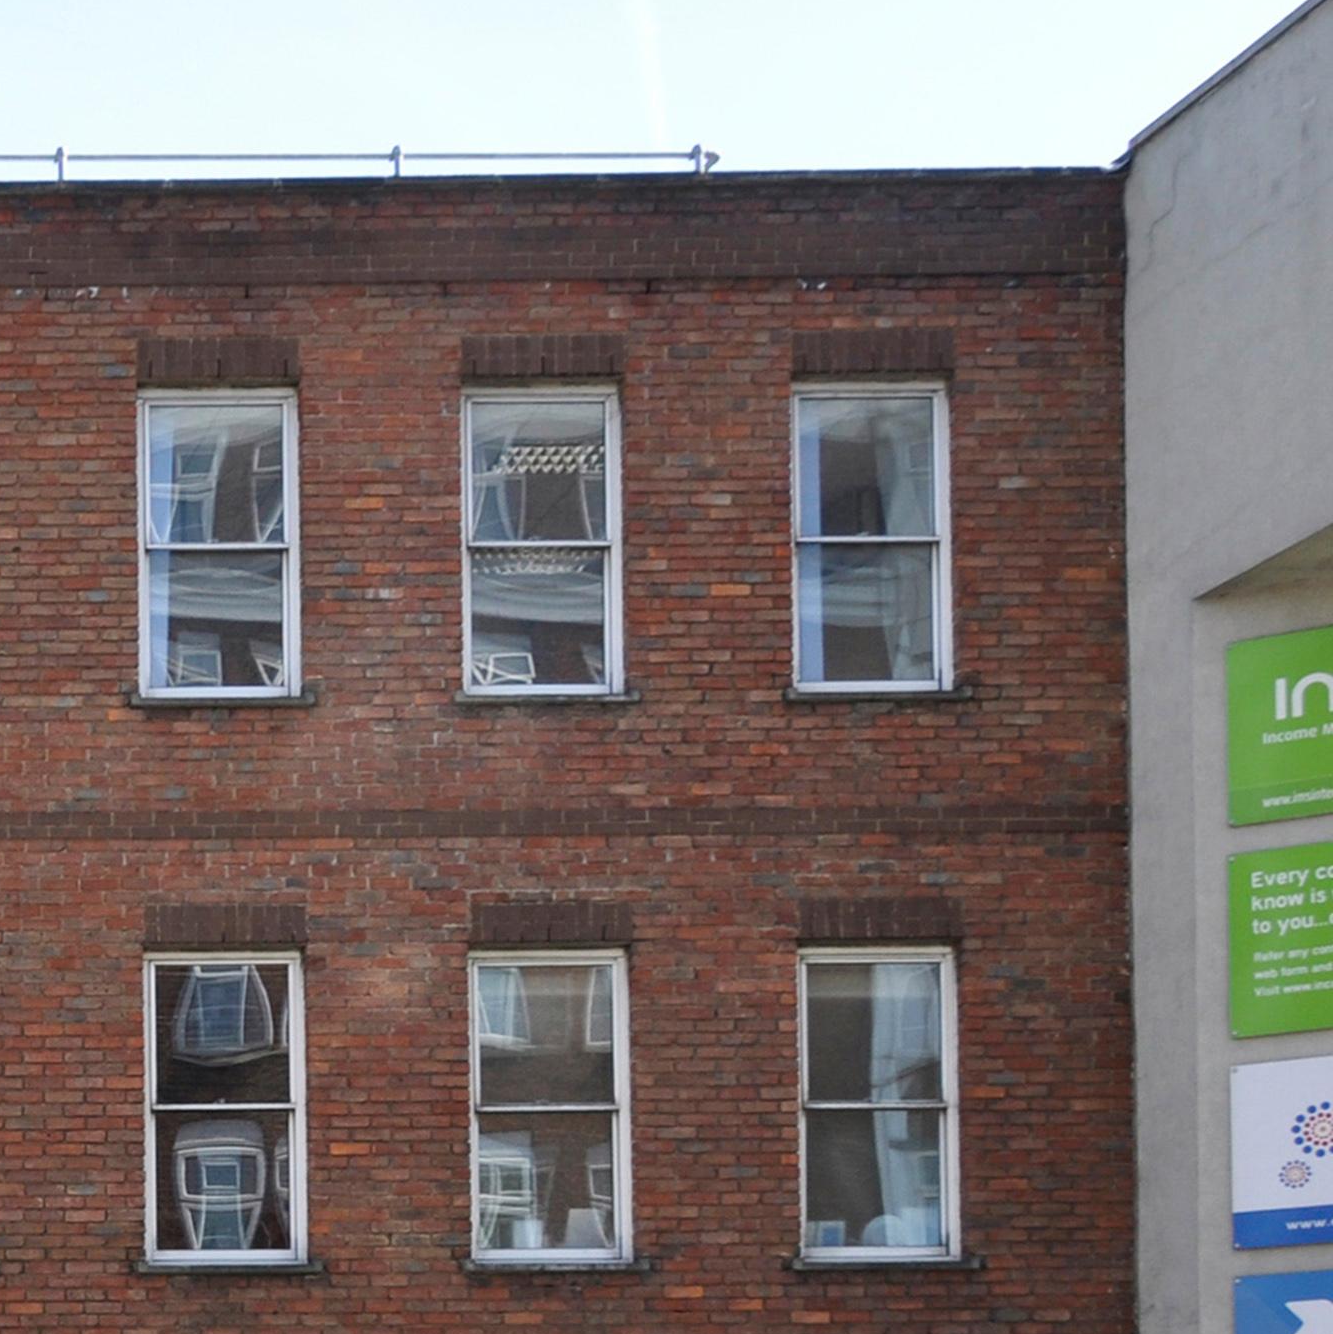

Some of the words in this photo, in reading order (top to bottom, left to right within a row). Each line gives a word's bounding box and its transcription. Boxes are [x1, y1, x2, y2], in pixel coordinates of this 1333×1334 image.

[1262, 727, 1317, 744] Income
[1251, 869, 1309, 888] Every
[1251, 893, 1305, 911] know
[1310, 888, 1326, 903] is
[1252, 919, 1271, 934] to
